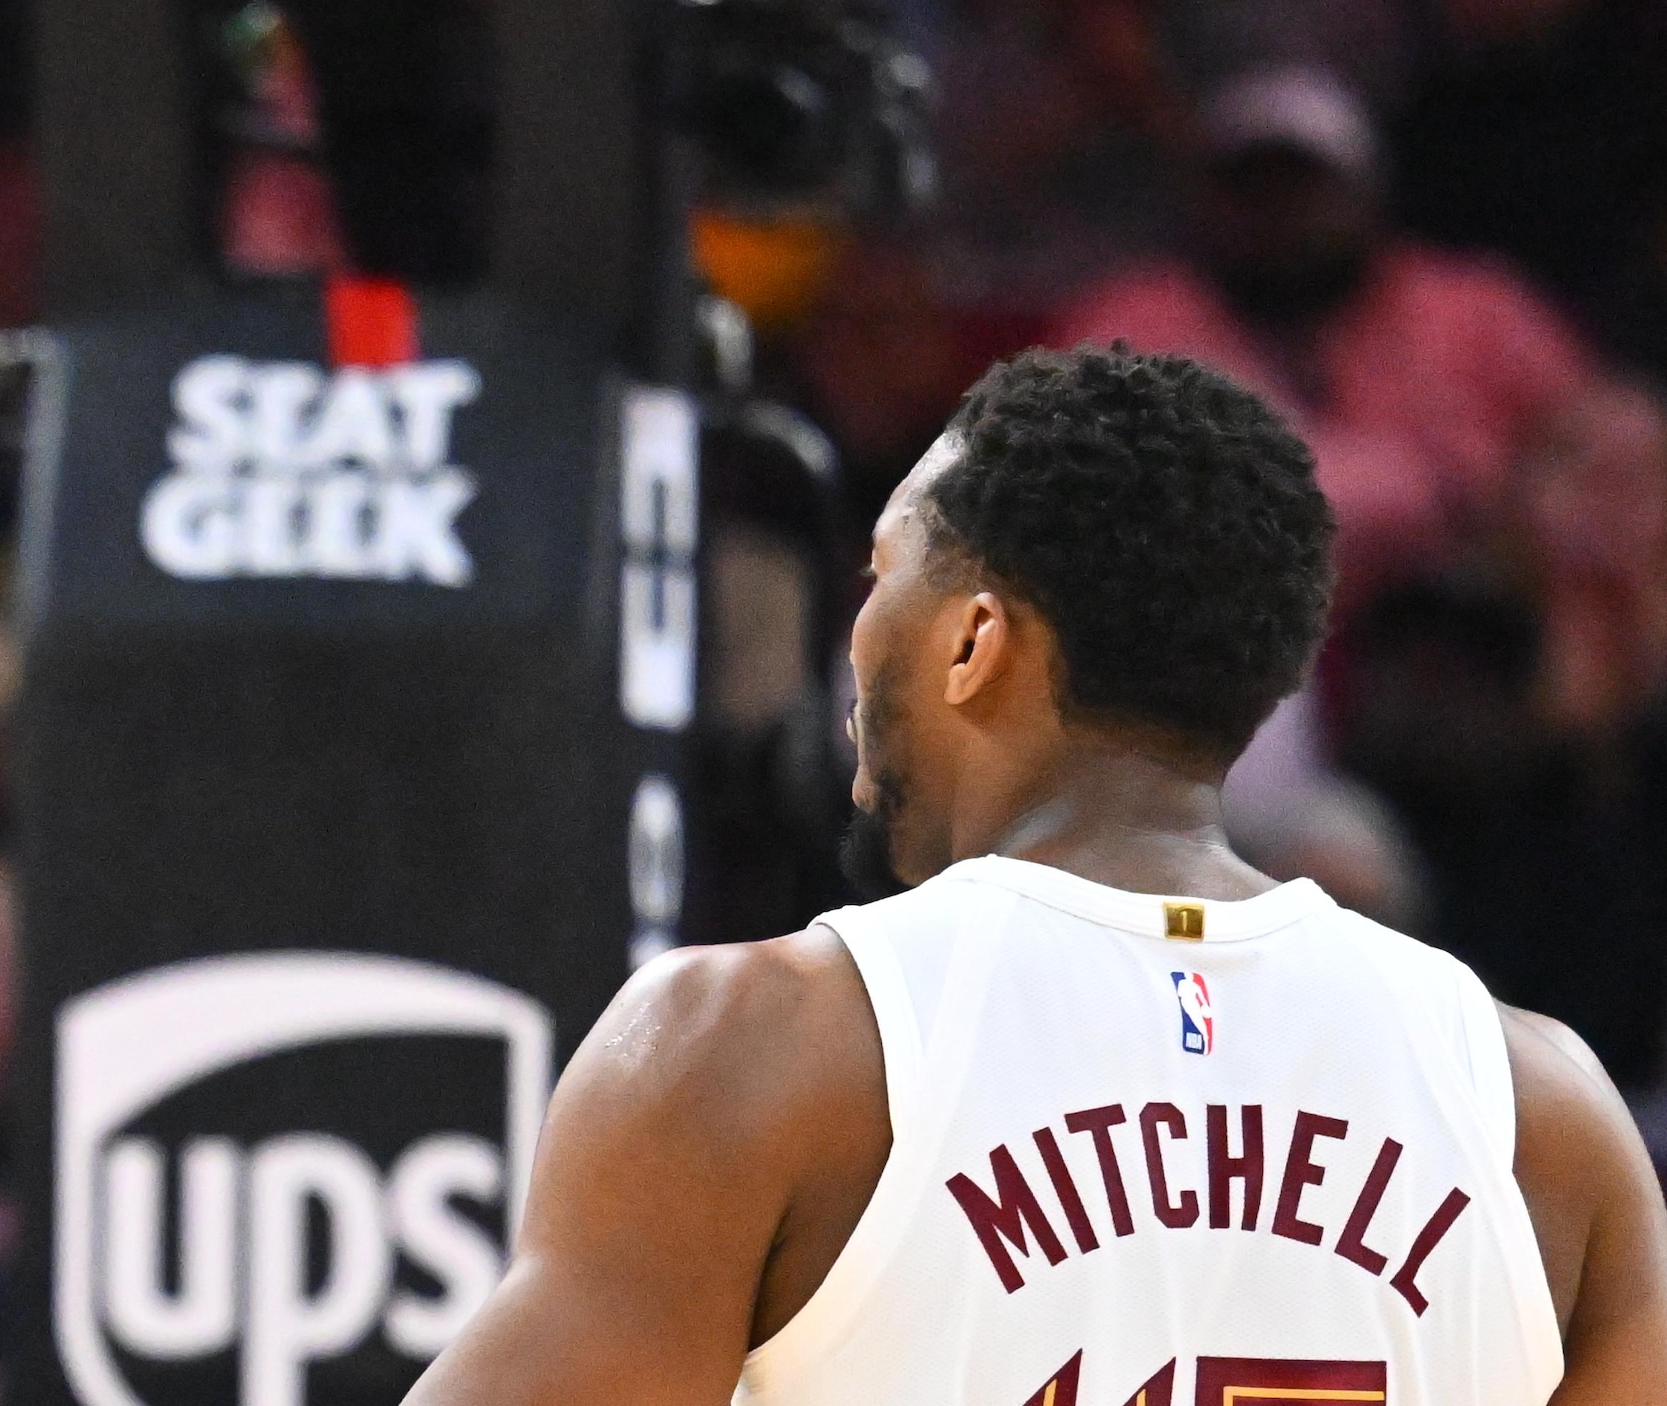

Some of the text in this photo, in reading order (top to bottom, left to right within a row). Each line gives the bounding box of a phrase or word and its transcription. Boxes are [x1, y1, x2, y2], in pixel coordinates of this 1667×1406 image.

[169, 354, 480, 470] SEAT
[140, 468, 477, 587] GEEK
[946, 1102, 1472, 1318] MITCHELL
